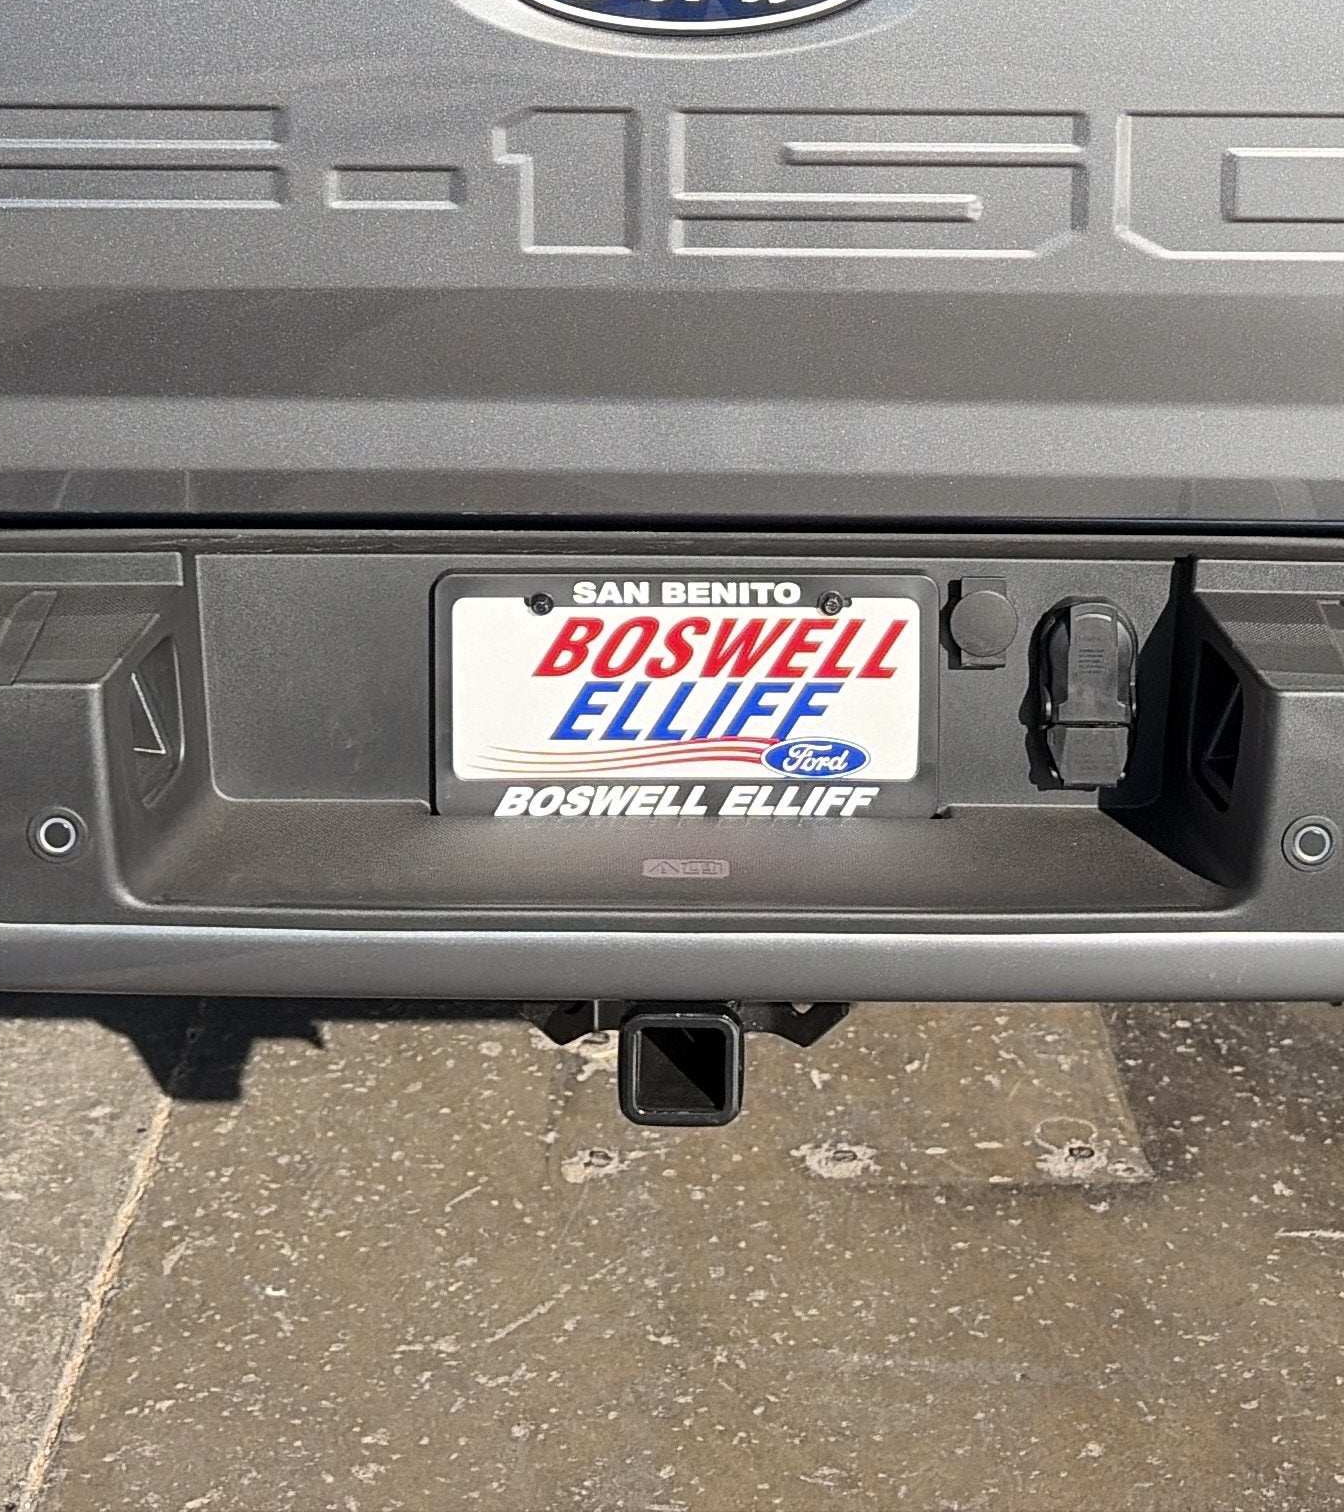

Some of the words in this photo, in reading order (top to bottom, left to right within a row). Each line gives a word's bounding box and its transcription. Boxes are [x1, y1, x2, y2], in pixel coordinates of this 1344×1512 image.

[572, 581, 649, 605] SAN
[661, 581, 801, 605] BENITO
[532, 616, 909, 678] BOSWELL
[548, 681, 845, 741] ELLIFF
[782, 743, 851, 772] Ford
[494, 786, 708, 817] BOSWELL
[718, 786, 880, 817] ELLIFF
